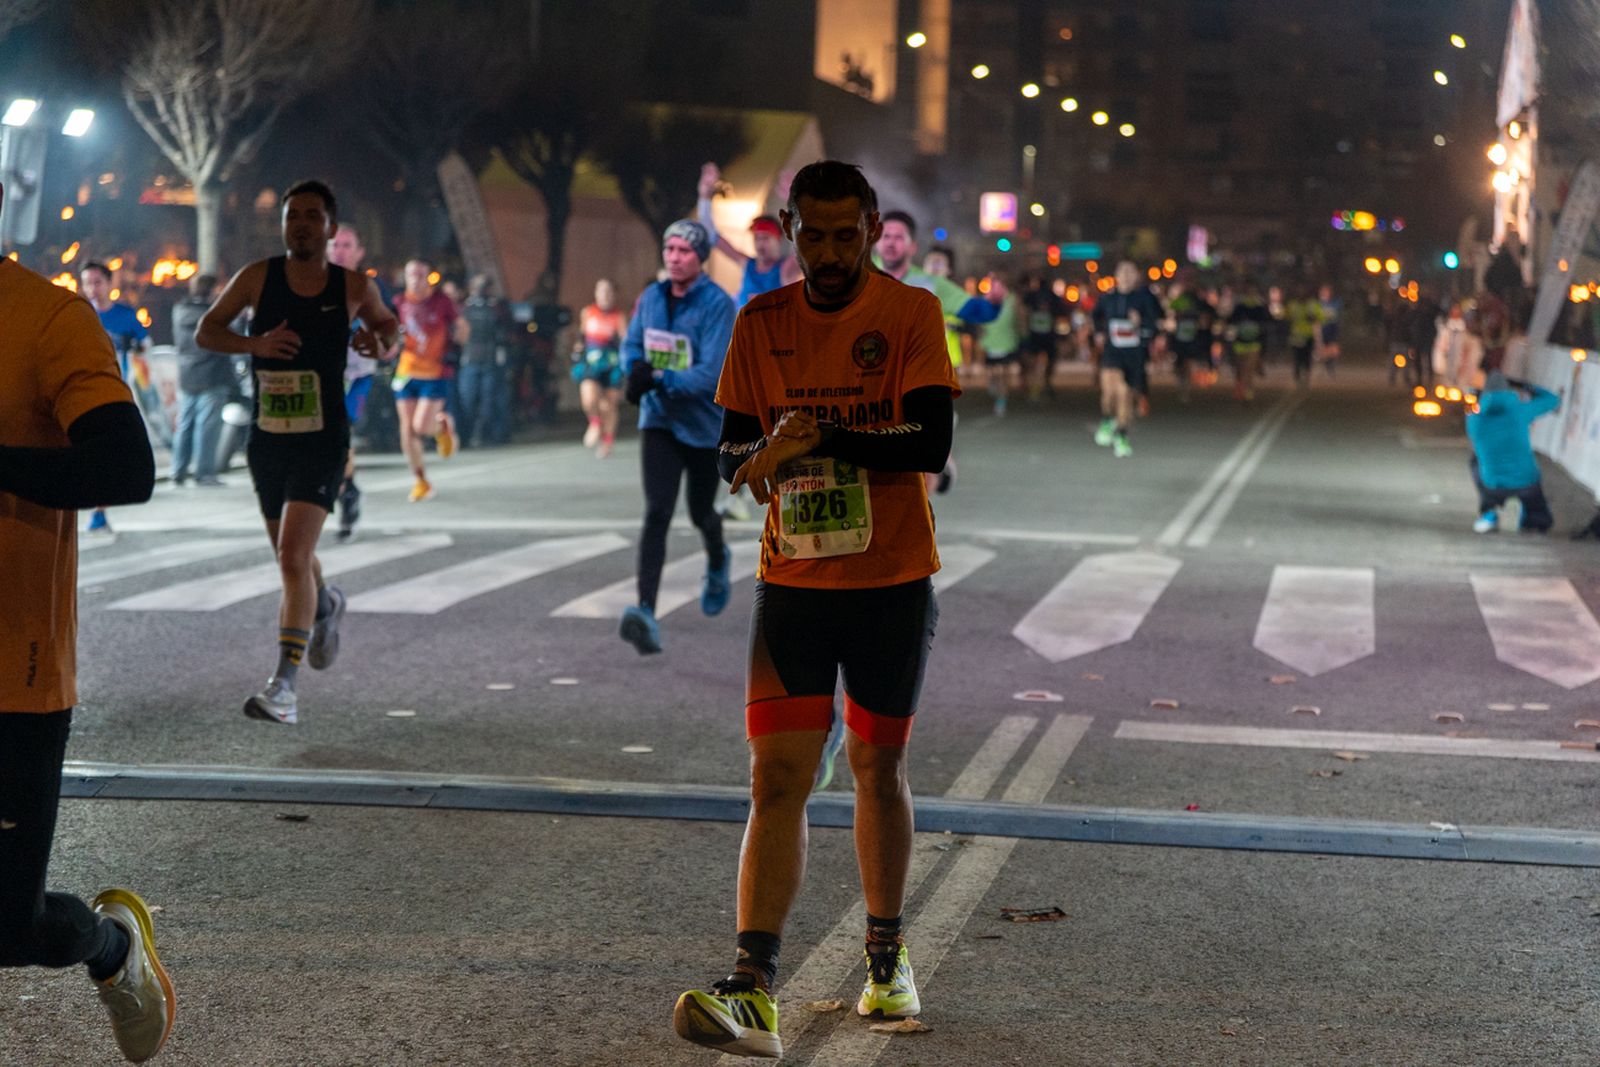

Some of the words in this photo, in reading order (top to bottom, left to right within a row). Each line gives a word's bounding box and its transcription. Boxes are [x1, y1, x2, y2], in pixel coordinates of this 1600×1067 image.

[785, 387, 805, 400] CLUB
[807, 387, 818, 399] DE
[819, 385, 864, 399] ATLETISMO
[269, 393, 304, 412] 7517
[769, 397, 893, 428] QURAJANO
[811, 466, 825, 477] DE
